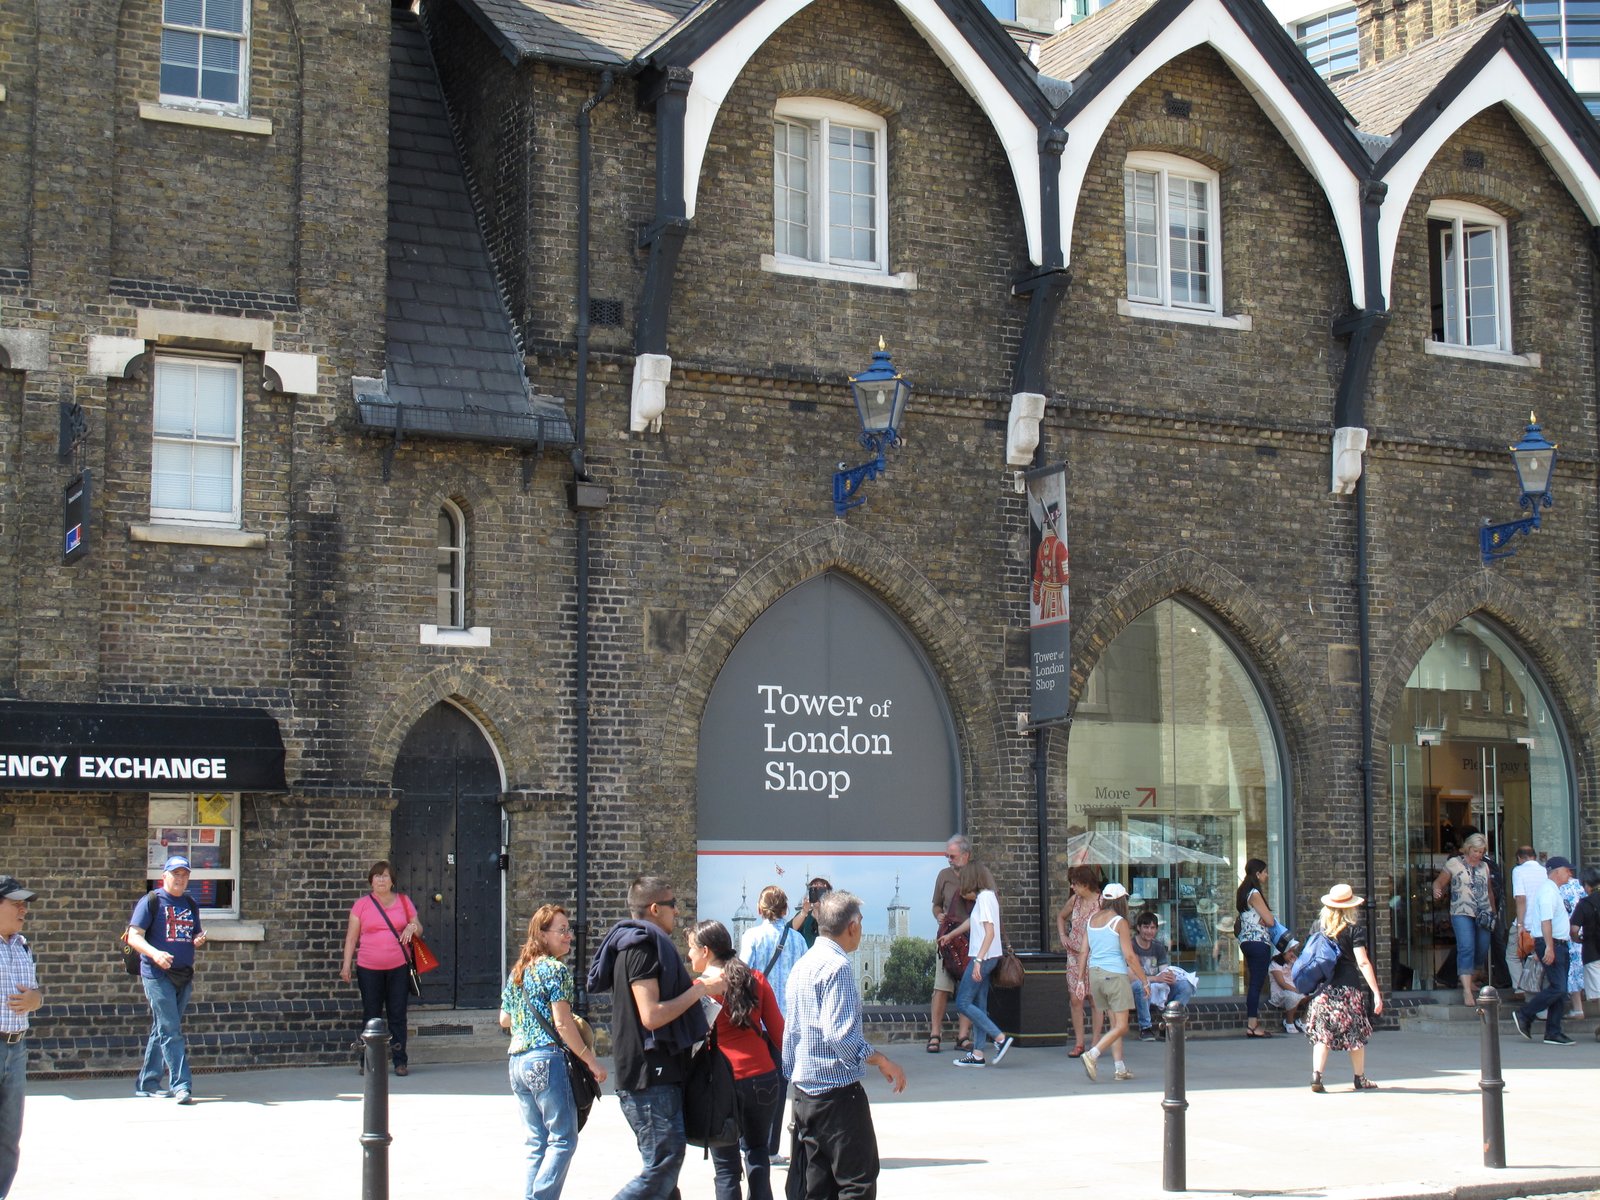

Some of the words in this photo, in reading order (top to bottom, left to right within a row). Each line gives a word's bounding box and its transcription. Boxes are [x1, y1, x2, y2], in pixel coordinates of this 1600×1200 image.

[1034, 651, 1058, 663] Tower
[1058, 651, 1065, 660] of
[1036, 664, 1065, 677] London
[1036, 679, 1056, 690] Shop
[757, 684, 863, 717] Tower
[869, 699, 892, 718] of
[763, 723, 893, 755] London
[79, 756, 227, 779] EXCHANGE
[1462, 758, 1499, 770] Ple
[764, 760, 851, 799] Shop
[1095, 786, 1131, 800] More
